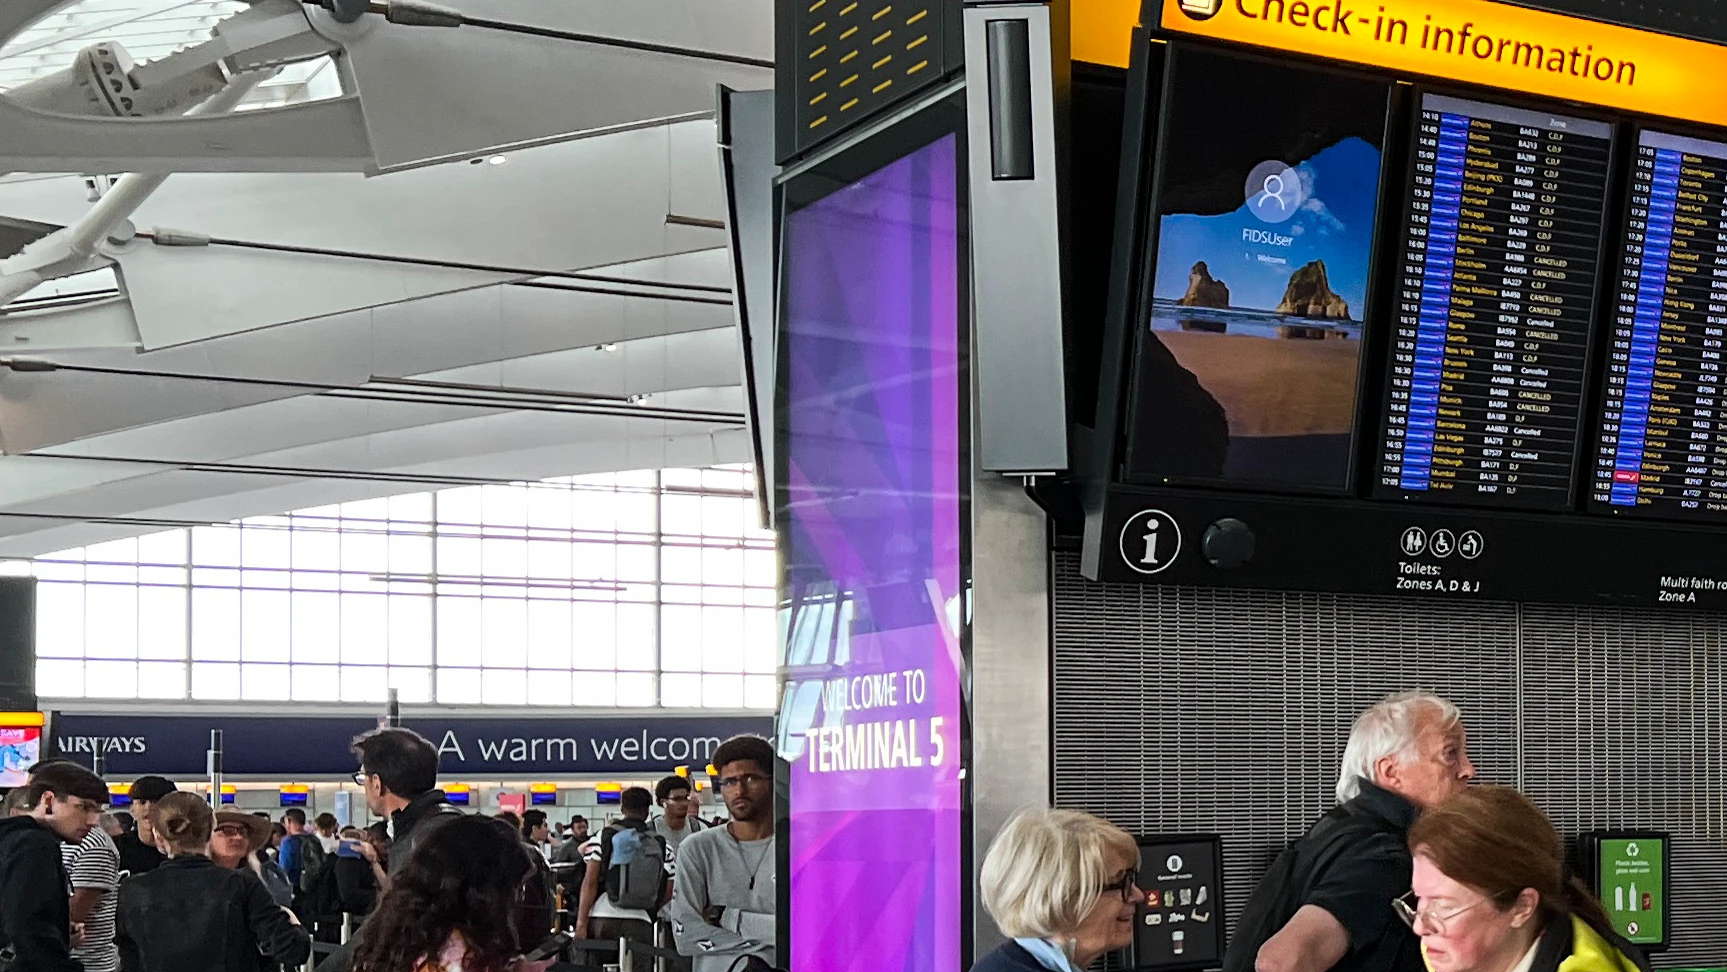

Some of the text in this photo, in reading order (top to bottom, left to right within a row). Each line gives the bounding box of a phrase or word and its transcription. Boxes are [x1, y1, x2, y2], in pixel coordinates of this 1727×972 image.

[1421, 15, 1637, 86] information
[1242, 228, 1293, 246] FIDSUser
[1534, 257, 1567, 267] CANCELLED
[1532, 269, 1565, 279] CANCELLED
[1529, 293, 1563, 303] CANCELLED
[1528, 306, 1561, 316] CANCELLED
[1525, 330, 1558, 340] CANCELLED
[1518, 391, 1551, 400] CANCELLED
[1516, 403, 1550, 412] CANCELLED
[1399, 562, 1441, 575] Toilets:
[1396, 577, 1479, 592] Zones A, D & J
[1661, 576, 1689, 588] Multi
[1691, 577, 1715, 589] faith
[1659, 591, 1695, 602] Zone A
[822, 669, 925, 712] WELCOME TO
[436, 729, 721, 762] A warm welcom
[806, 717, 943, 772] TERMINAL 5
